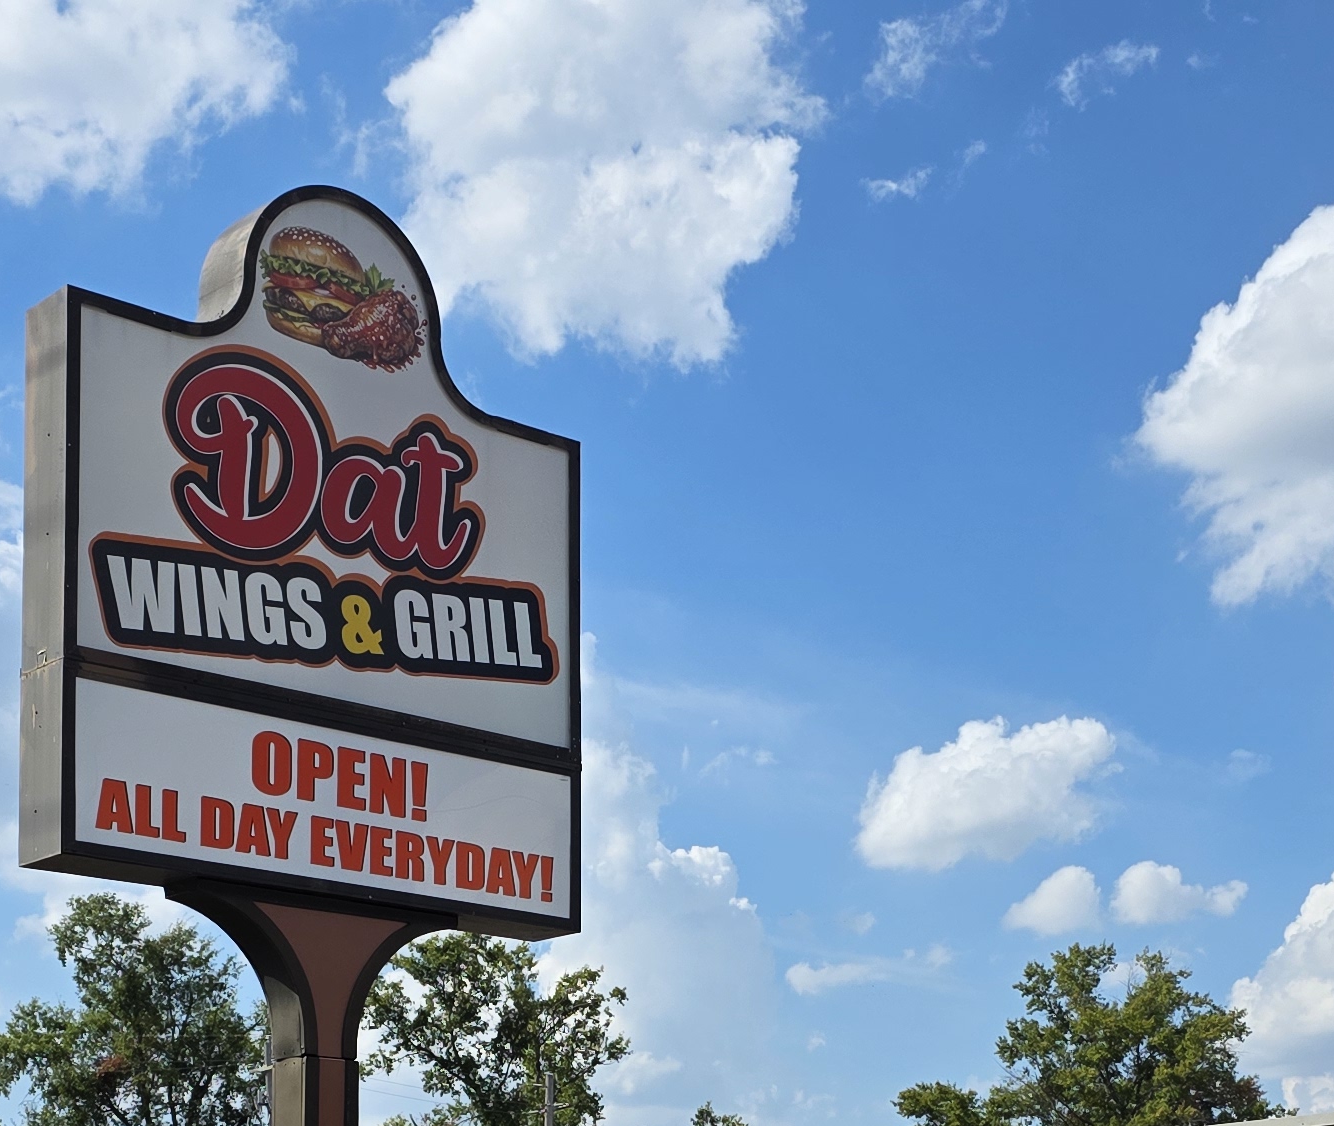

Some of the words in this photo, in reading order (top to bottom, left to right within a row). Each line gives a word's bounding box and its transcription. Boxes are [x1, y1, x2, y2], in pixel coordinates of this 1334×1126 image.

[173, 362, 473, 570] Dat
[107, 554, 325, 650] WINGS
[341, 594, 384, 656] &
[394, 589, 543, 668] GRILL
[251, 730, 429, 822] OPEN!
[95, 777, 187, 843] ALL
[200, 796, 299, 861] DAY
[310, 815, 555, 903] EVERYDAY!
